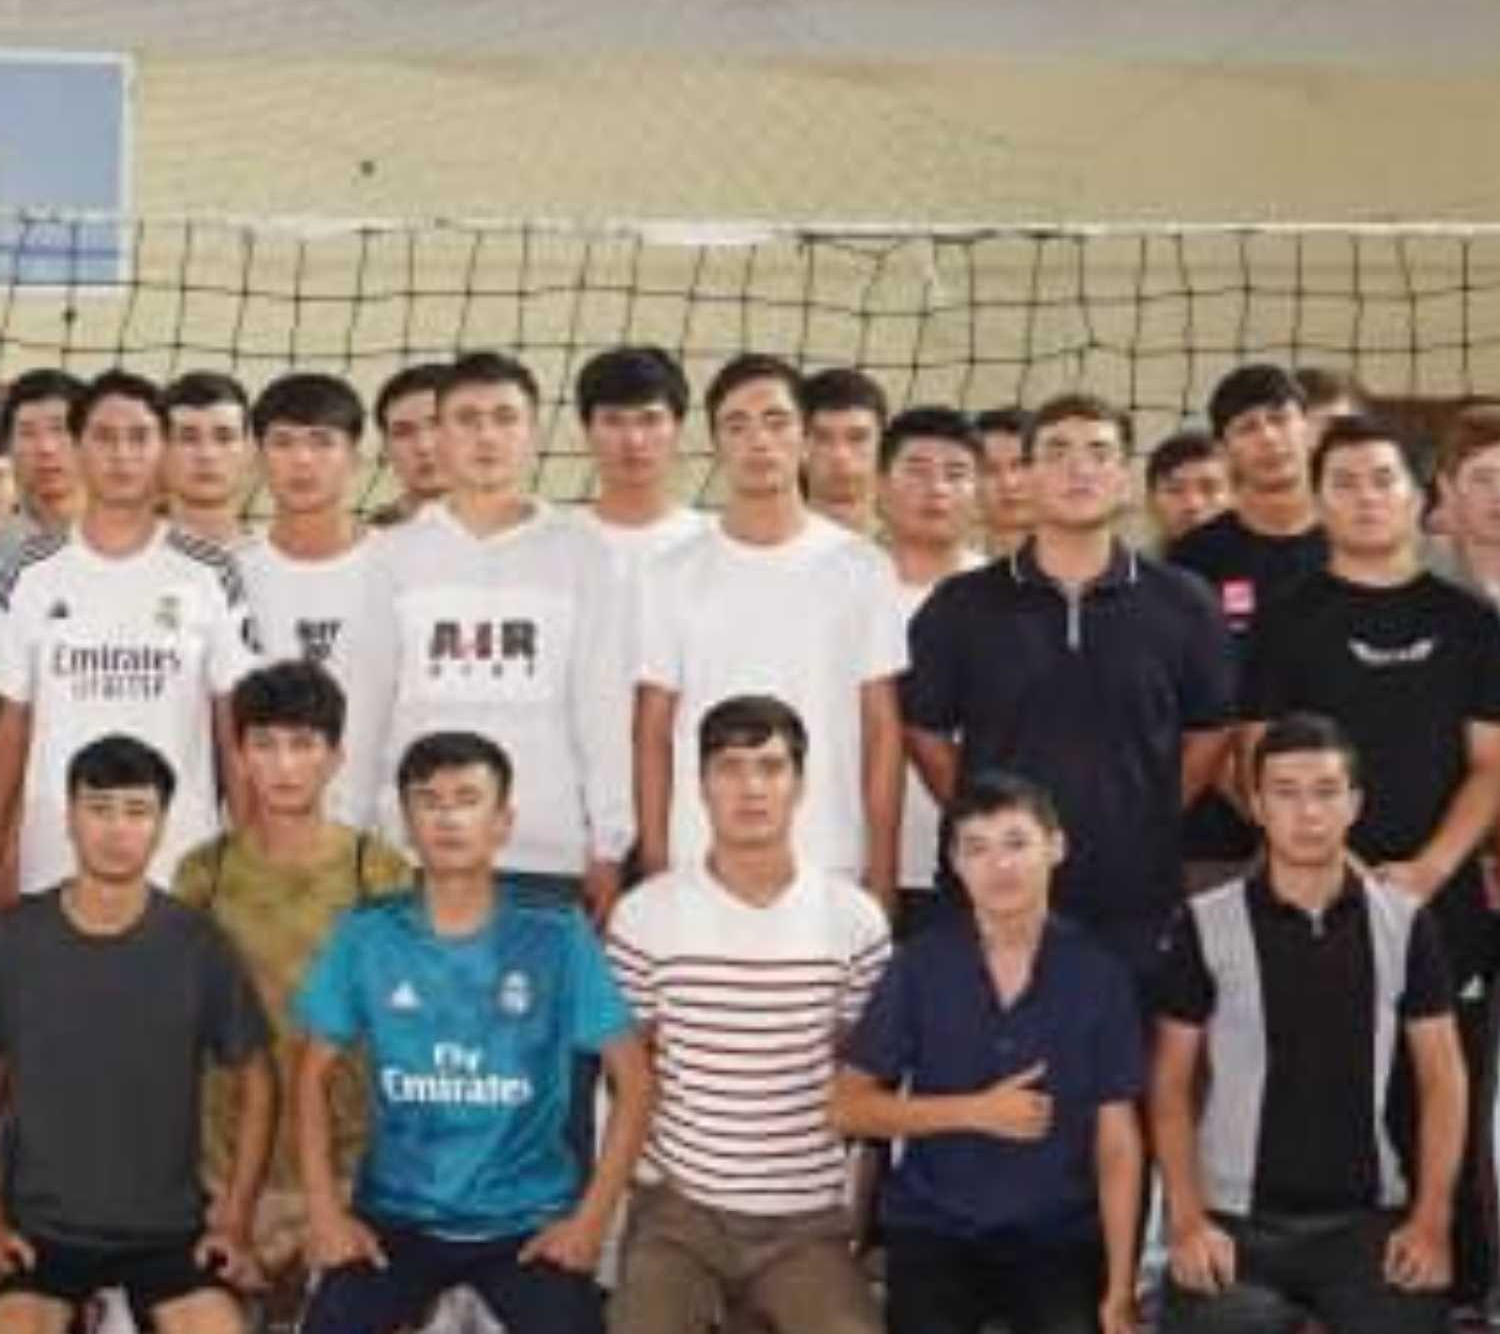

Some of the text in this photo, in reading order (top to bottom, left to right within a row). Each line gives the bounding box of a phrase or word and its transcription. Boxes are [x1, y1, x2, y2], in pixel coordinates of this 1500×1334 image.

[53, 642, 182, 676] Emirates
[430, 620, 536, 660] AIR
[380, 1067, 537, 1105] Emirates
